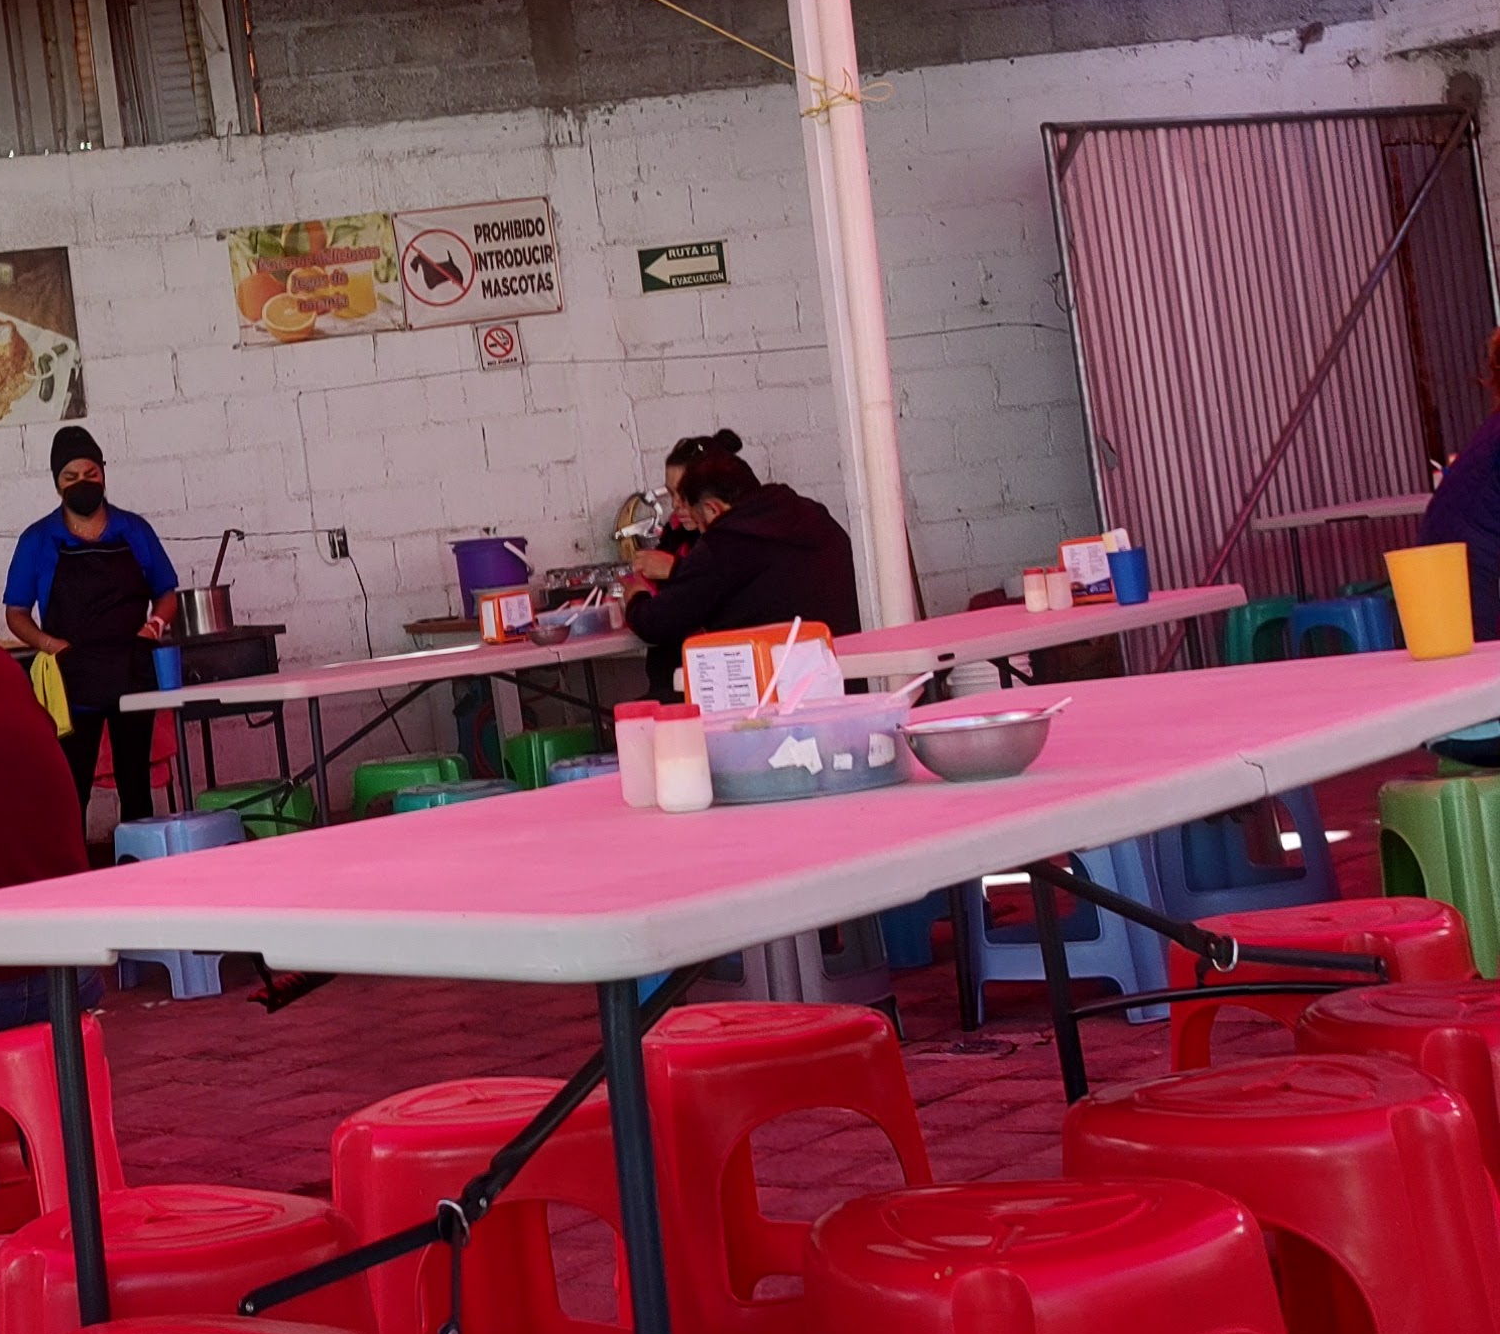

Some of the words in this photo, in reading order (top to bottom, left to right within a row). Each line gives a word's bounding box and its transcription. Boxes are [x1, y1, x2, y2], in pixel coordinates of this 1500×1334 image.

[474, 217, 545, 244] PROHIBIDO
[474, 245, 554, 272] INTRODUCIR
[668, 246, 699, 259] RUTA
[702, 244, 718, 254] DE
[481, 273, 554, 299] MASCOTAS
